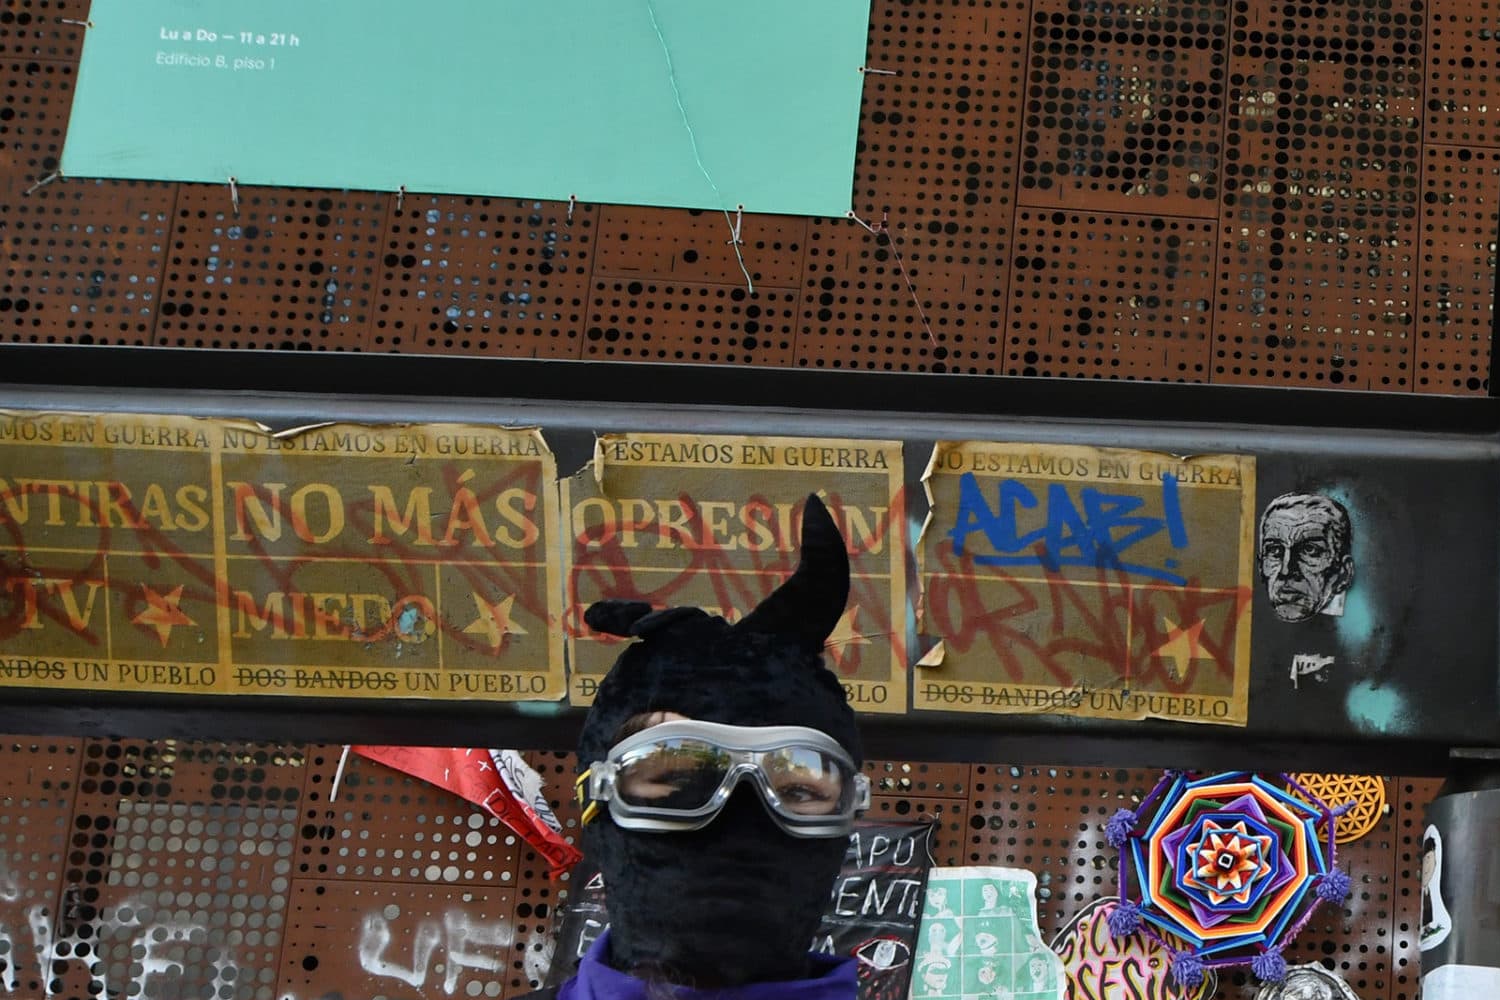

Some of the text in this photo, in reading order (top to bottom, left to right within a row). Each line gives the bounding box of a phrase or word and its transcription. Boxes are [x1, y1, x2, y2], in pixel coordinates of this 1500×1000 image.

[160, 27, 179, 40] Lu
[183, 31, 191, 40] a
[196, 28, 218, 42] Do
[240, 32, 252, 44] 11
[256, 34, 265, 45] a
[269, 33, 285, 46] 21
[289, 34, 300, 46] h
[156, 52, 211, 66] Edificio
[234, 56, 265, 72] piso
[61, 422, 97, 442] EN
[104, 425, 210, 448] GUERRA
[223, 430, 541, 456] NO ESTAMOS EN GUERRA
[615, 442, 889, 469] ESTAMOS EN GUERRA
[972, 453, 1089, 478] ESTAMOS
[1098, 457, 1130, 481] EN
[1139, 461, 1241, 486] GUERRA
[227, 468, 539, 549] NO MÁS
[572, 489, 889, 554] OPRESIN
[232, 591, 436, 642] MIEDO
[75, 662, 108, 683] UN
[119, 663, 216, 686] PUEBLO
[235, 668, 546, 693] DOS BANDOS UN PUEBLO
[925, 684, 974, 704] DOS
[1088, 690, 1124, 712] UN
[1133, 693, 1230, 718] PUEBLO
